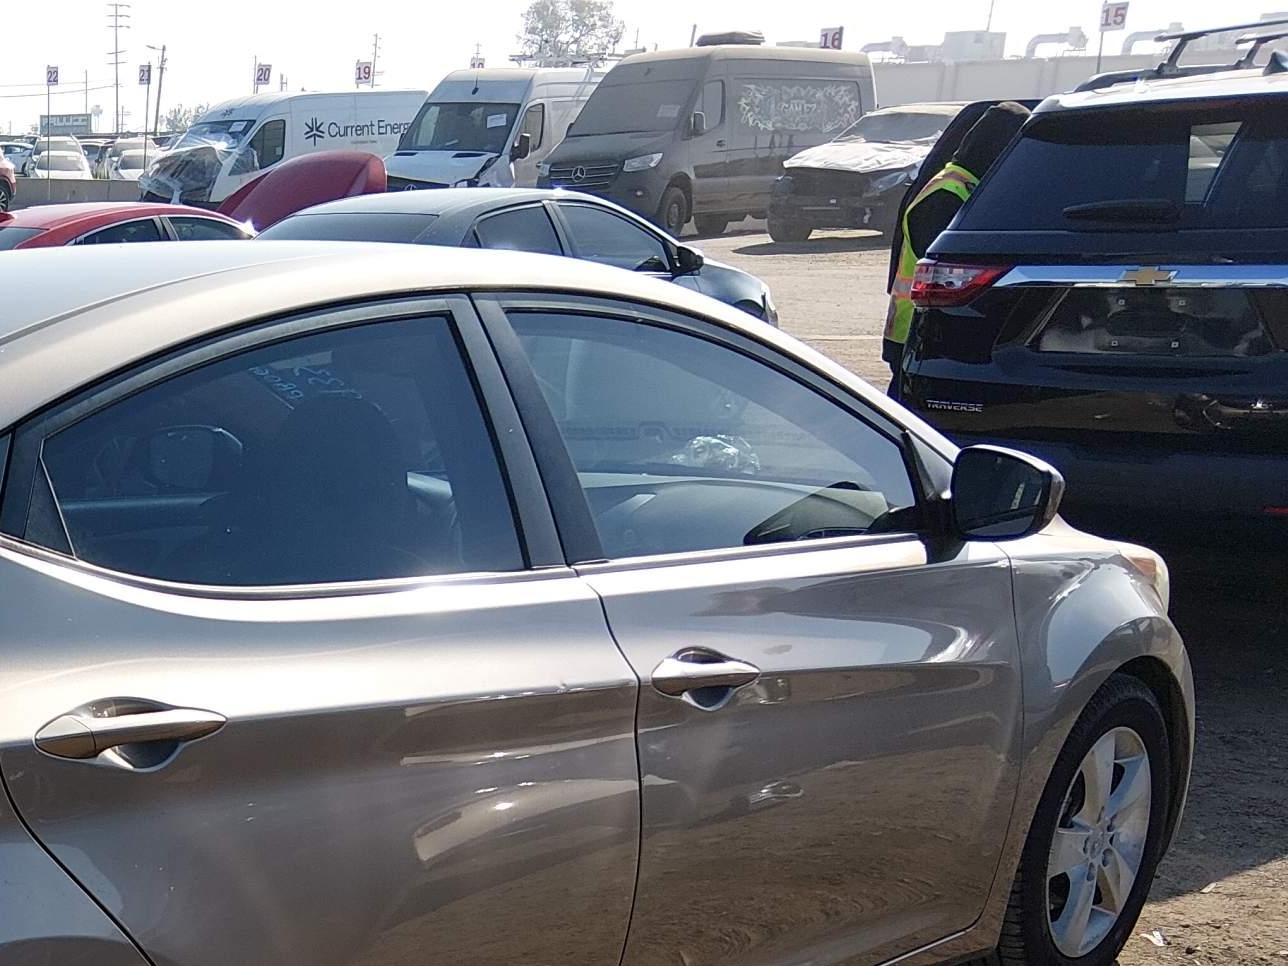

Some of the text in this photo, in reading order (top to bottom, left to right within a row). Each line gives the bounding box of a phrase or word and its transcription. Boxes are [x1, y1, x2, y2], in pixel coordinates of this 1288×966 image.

[1101, 6, 1127, 26] 15
[47, 70, 57, 82] 22
[257, 67, 270, 81] 20
[356, 65, 371, 80] 19
[328, 121, 375, 137] Current
[926, 399, 984, 412] TRAVERSE
